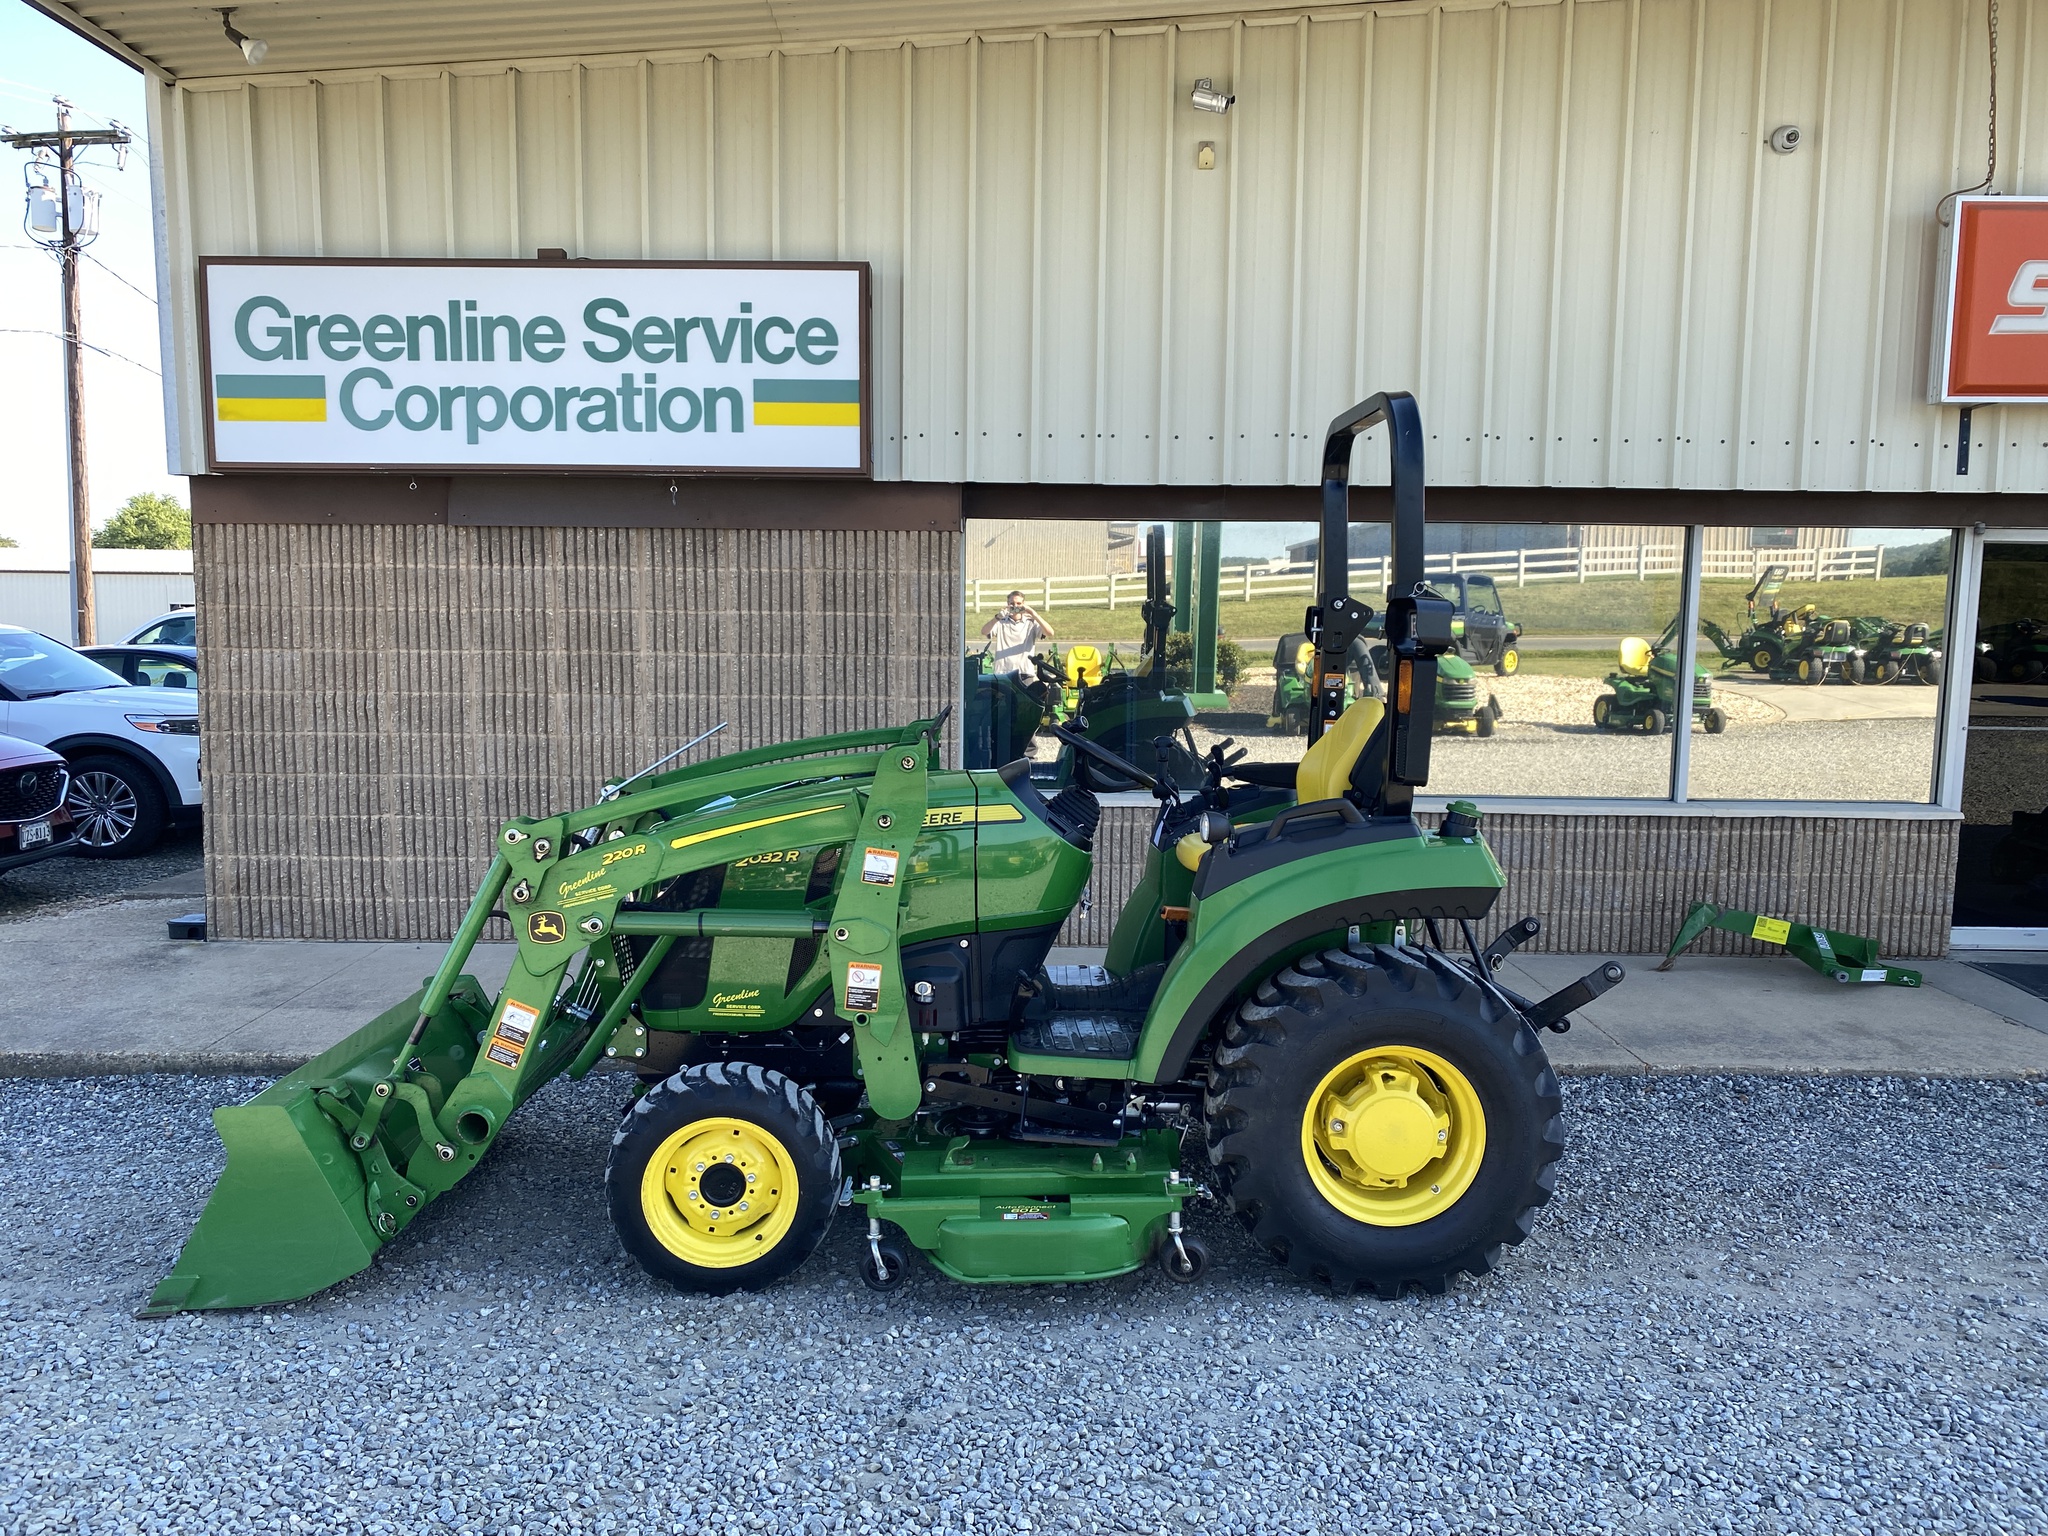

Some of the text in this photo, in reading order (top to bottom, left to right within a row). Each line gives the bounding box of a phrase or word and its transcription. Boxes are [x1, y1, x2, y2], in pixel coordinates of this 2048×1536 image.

[234, 295, 840, 366] Greenline Service
[338, 366, 745, 446] Corporation
[559, 867, 607, 899] Greenline
[712, 989, 760, 1008] Greenline
